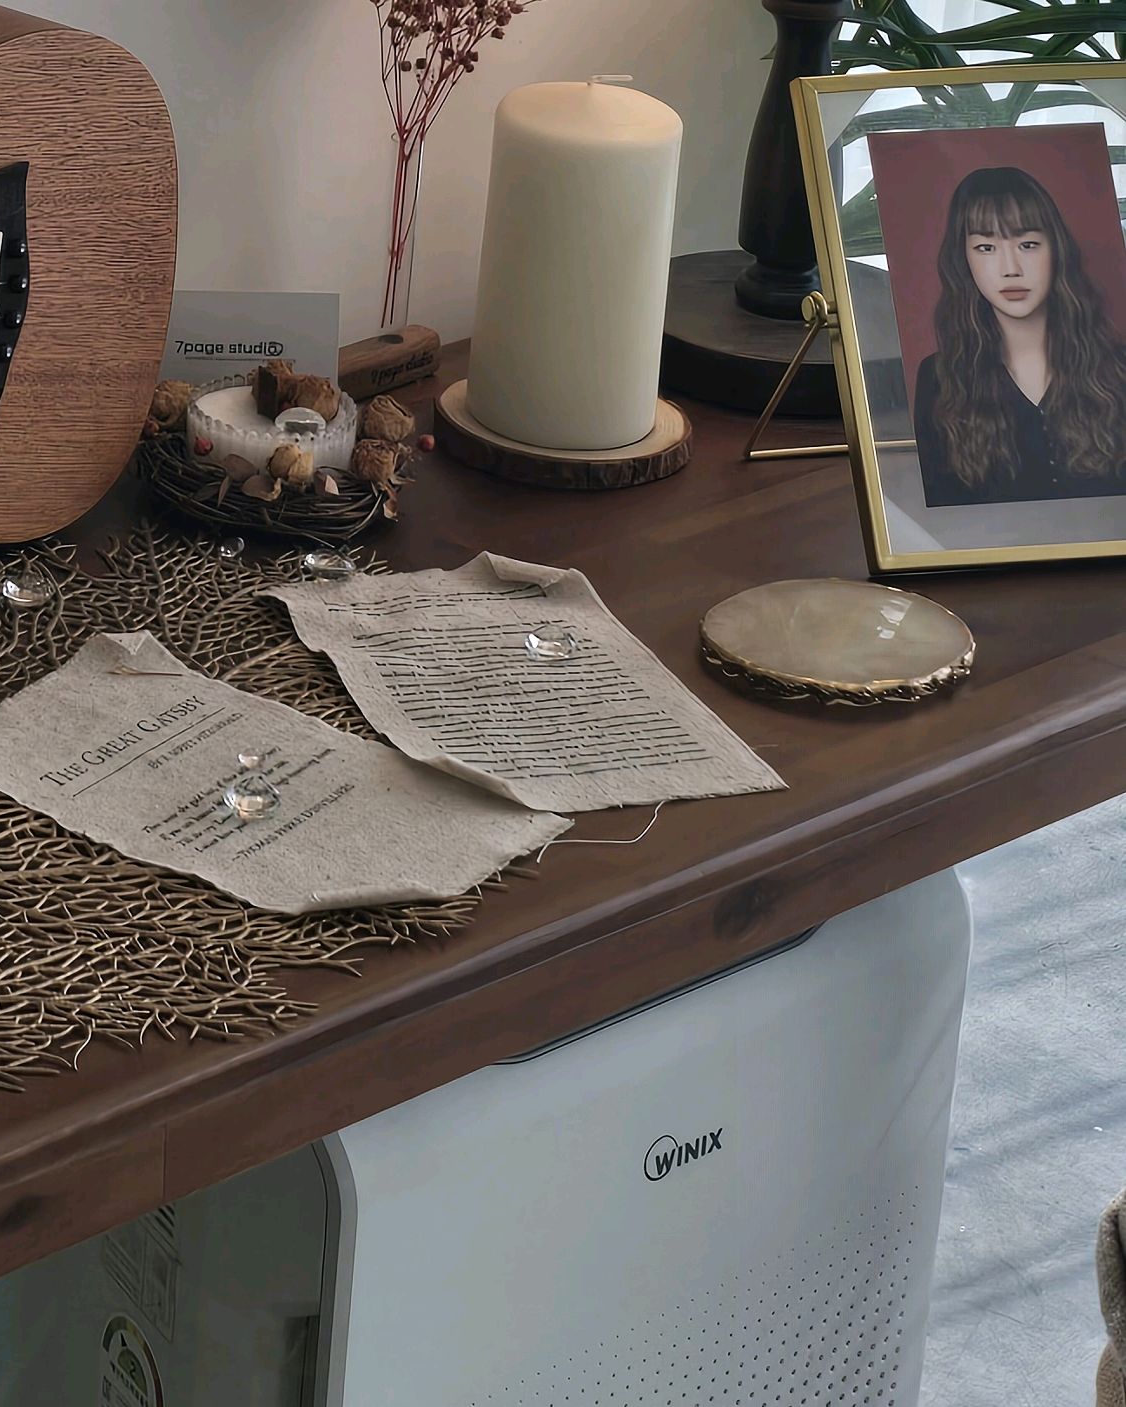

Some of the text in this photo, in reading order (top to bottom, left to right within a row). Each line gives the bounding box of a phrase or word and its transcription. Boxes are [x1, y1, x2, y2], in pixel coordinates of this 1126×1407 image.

[175, 341, 284, 357] 7page studio
[39, 762, 89, 787] THE
[81, 729, 144, 766] GREAT
[136, 694, 206, 733] GATSBY
[643, 1127, 723, 1181] WINIX
